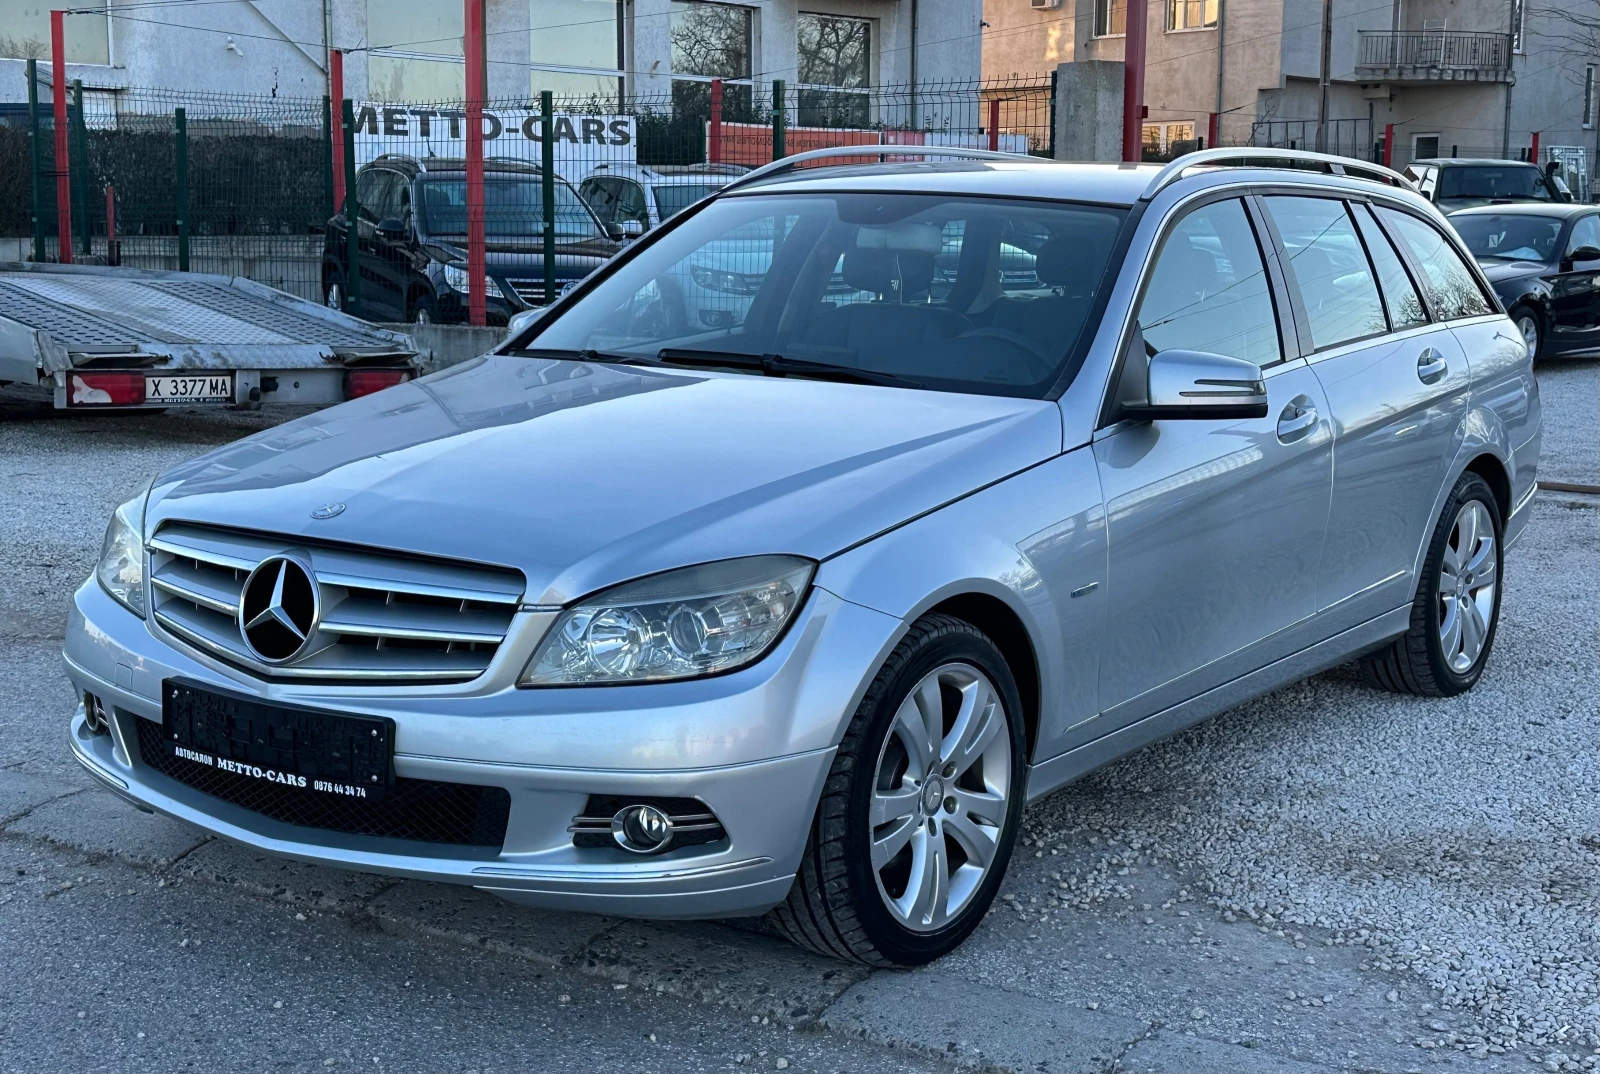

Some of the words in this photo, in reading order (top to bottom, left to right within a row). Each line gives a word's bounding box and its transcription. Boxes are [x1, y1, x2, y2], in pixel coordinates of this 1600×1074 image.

[352, 106, 631, 146] METTO-CARS
[170, 379, 206, 396] 3377
[209, 378, 228, 395] MA
[217, 757, 307, 788] METTO-CARS
[314, 779, 333, 793] 0876
[334, 783, 344, 794] 44
[345, 785, 355, 796] 34
[355, 786, 366, 798] 74
